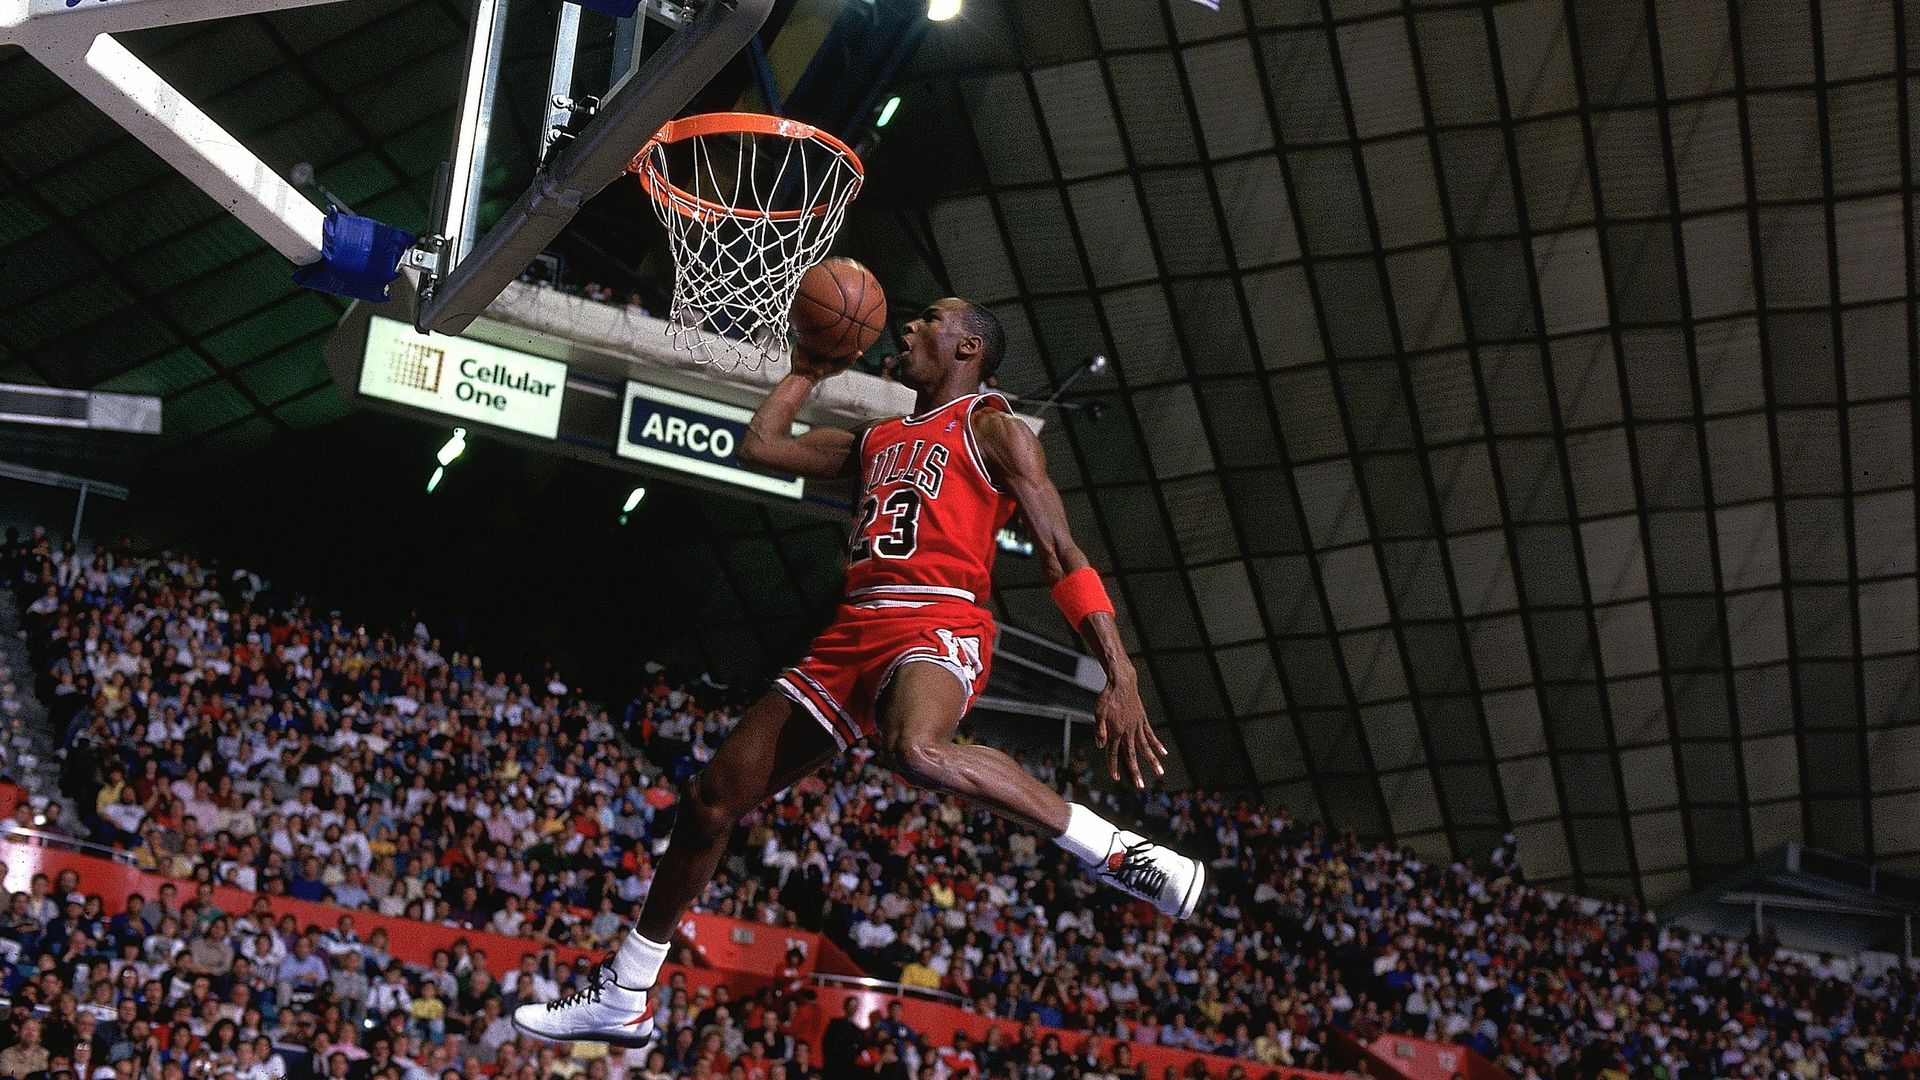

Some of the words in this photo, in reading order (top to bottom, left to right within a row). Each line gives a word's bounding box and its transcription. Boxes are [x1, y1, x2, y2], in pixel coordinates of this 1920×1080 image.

[456, 381, 507, 411] One
[460, 358, 556, 397] Cellular
[641, 413, 734, 458] ARCO
[864, 440, 950, 499] ULLS
[848, 488, 922, 569] 23
